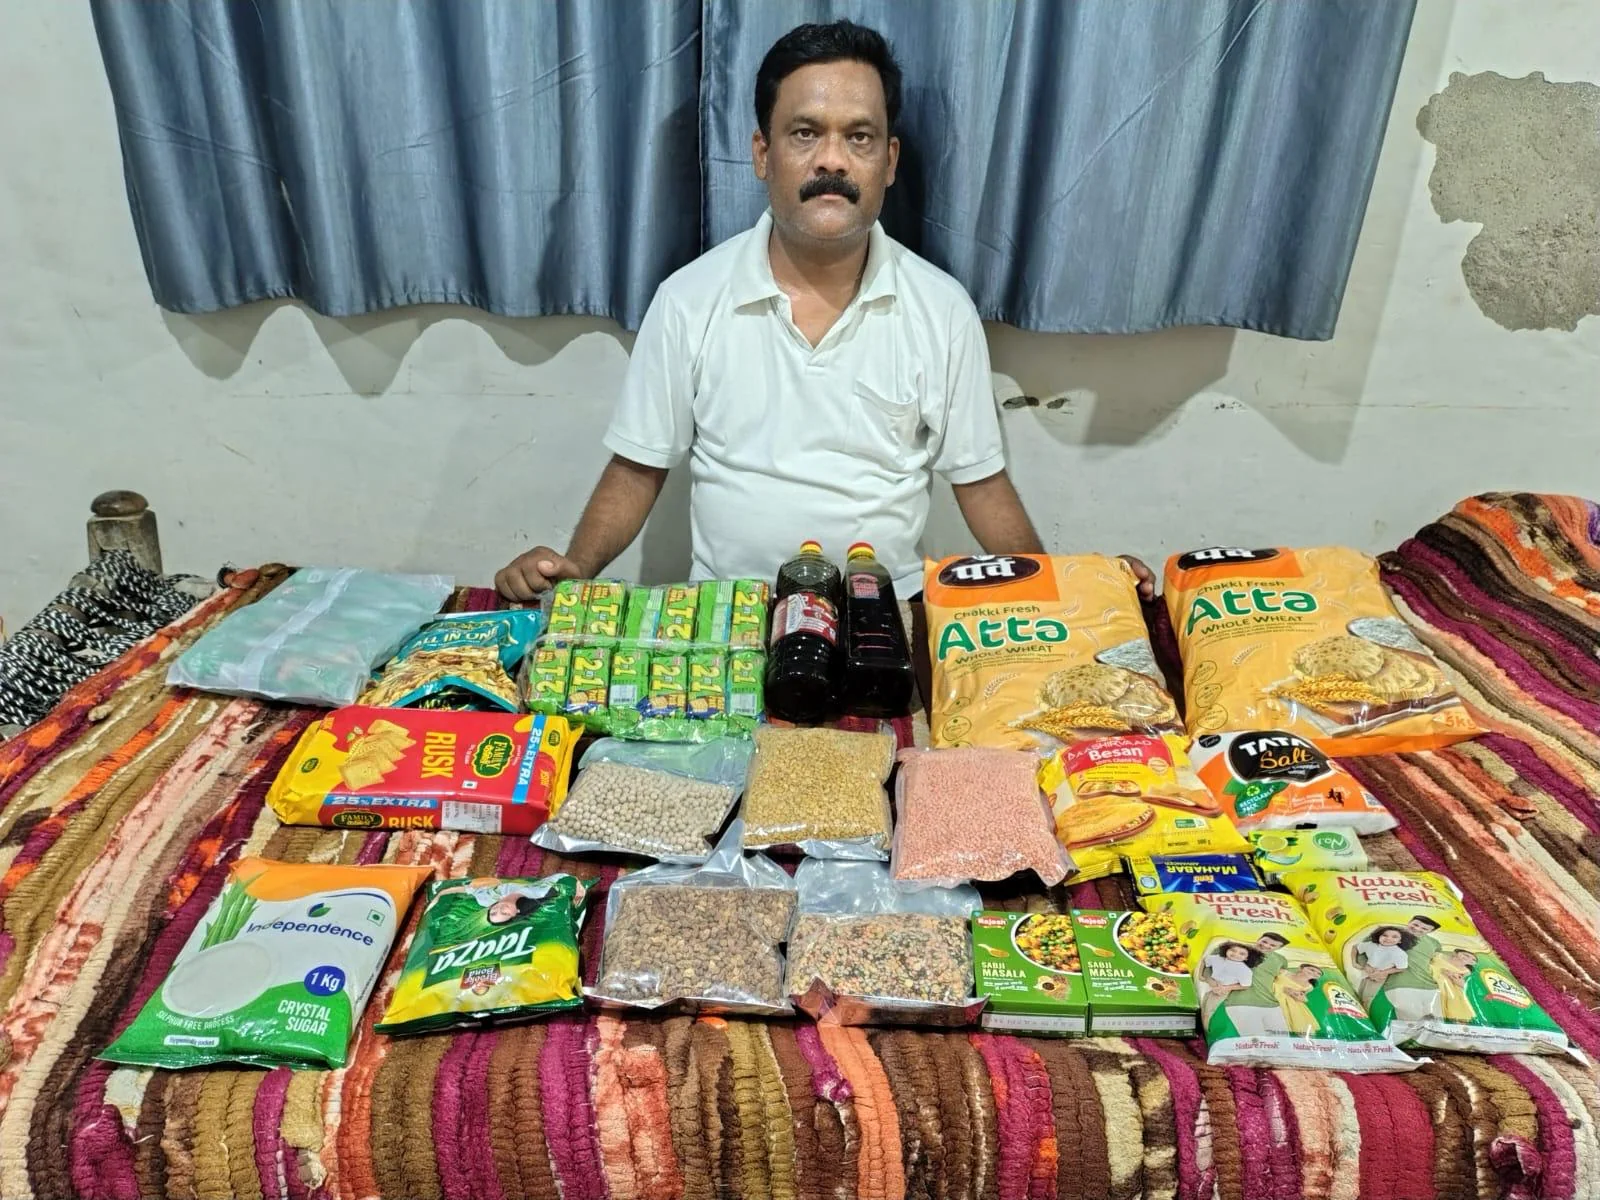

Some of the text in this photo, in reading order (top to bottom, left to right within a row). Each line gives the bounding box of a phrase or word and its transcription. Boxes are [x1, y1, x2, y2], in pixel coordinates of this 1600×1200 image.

[954, 605, 1040, 620] Chakki Fresh
[1186, 588, 1318, 636] Atta
[1253, 615, 1303, 623] WHEAT
[411, 636, 440, 650] ALL
[443, 632, 461, 642] IN
[937, 615, 1069, 662] Atta
[1006, 645, 1053, 655] WHEAT
[421, 732, 457, 778] RUSK
[1088, 747, 1143, 761] Besan
[1238, 737, 1312, 756] TATA
[487, 741, 508, 770] FAMILY
[1260, 748, 1314, 769] Salt
[519, 749, 538, 785] EXTRA
[371, 798, 432, 809] EXTRA
[341, 814, 376, 823] FAMILY
[388, 815, 434, 828] RUSK
[1166, 864, 1238, 876] MAHABAR
[1336, 876, 1437, 891] Nature
[1193, 893, 1292, 909] Nature
[1355, 888, 1443, 905] Fresh
[1209, 904, 1296, 922] Fresh
[246, 920, 374, 946] Independence
[982, 969, 1026, 978] MASALA
[1089, 968, 1134, 978] MASALA
[310, 972, 341, 992] 1 Kg
[277, 999, 331, 1022] CRYSTAL
[184, 1018, 202, 1030] FREE
[285, 1016, 328, 1037] SUGAR
